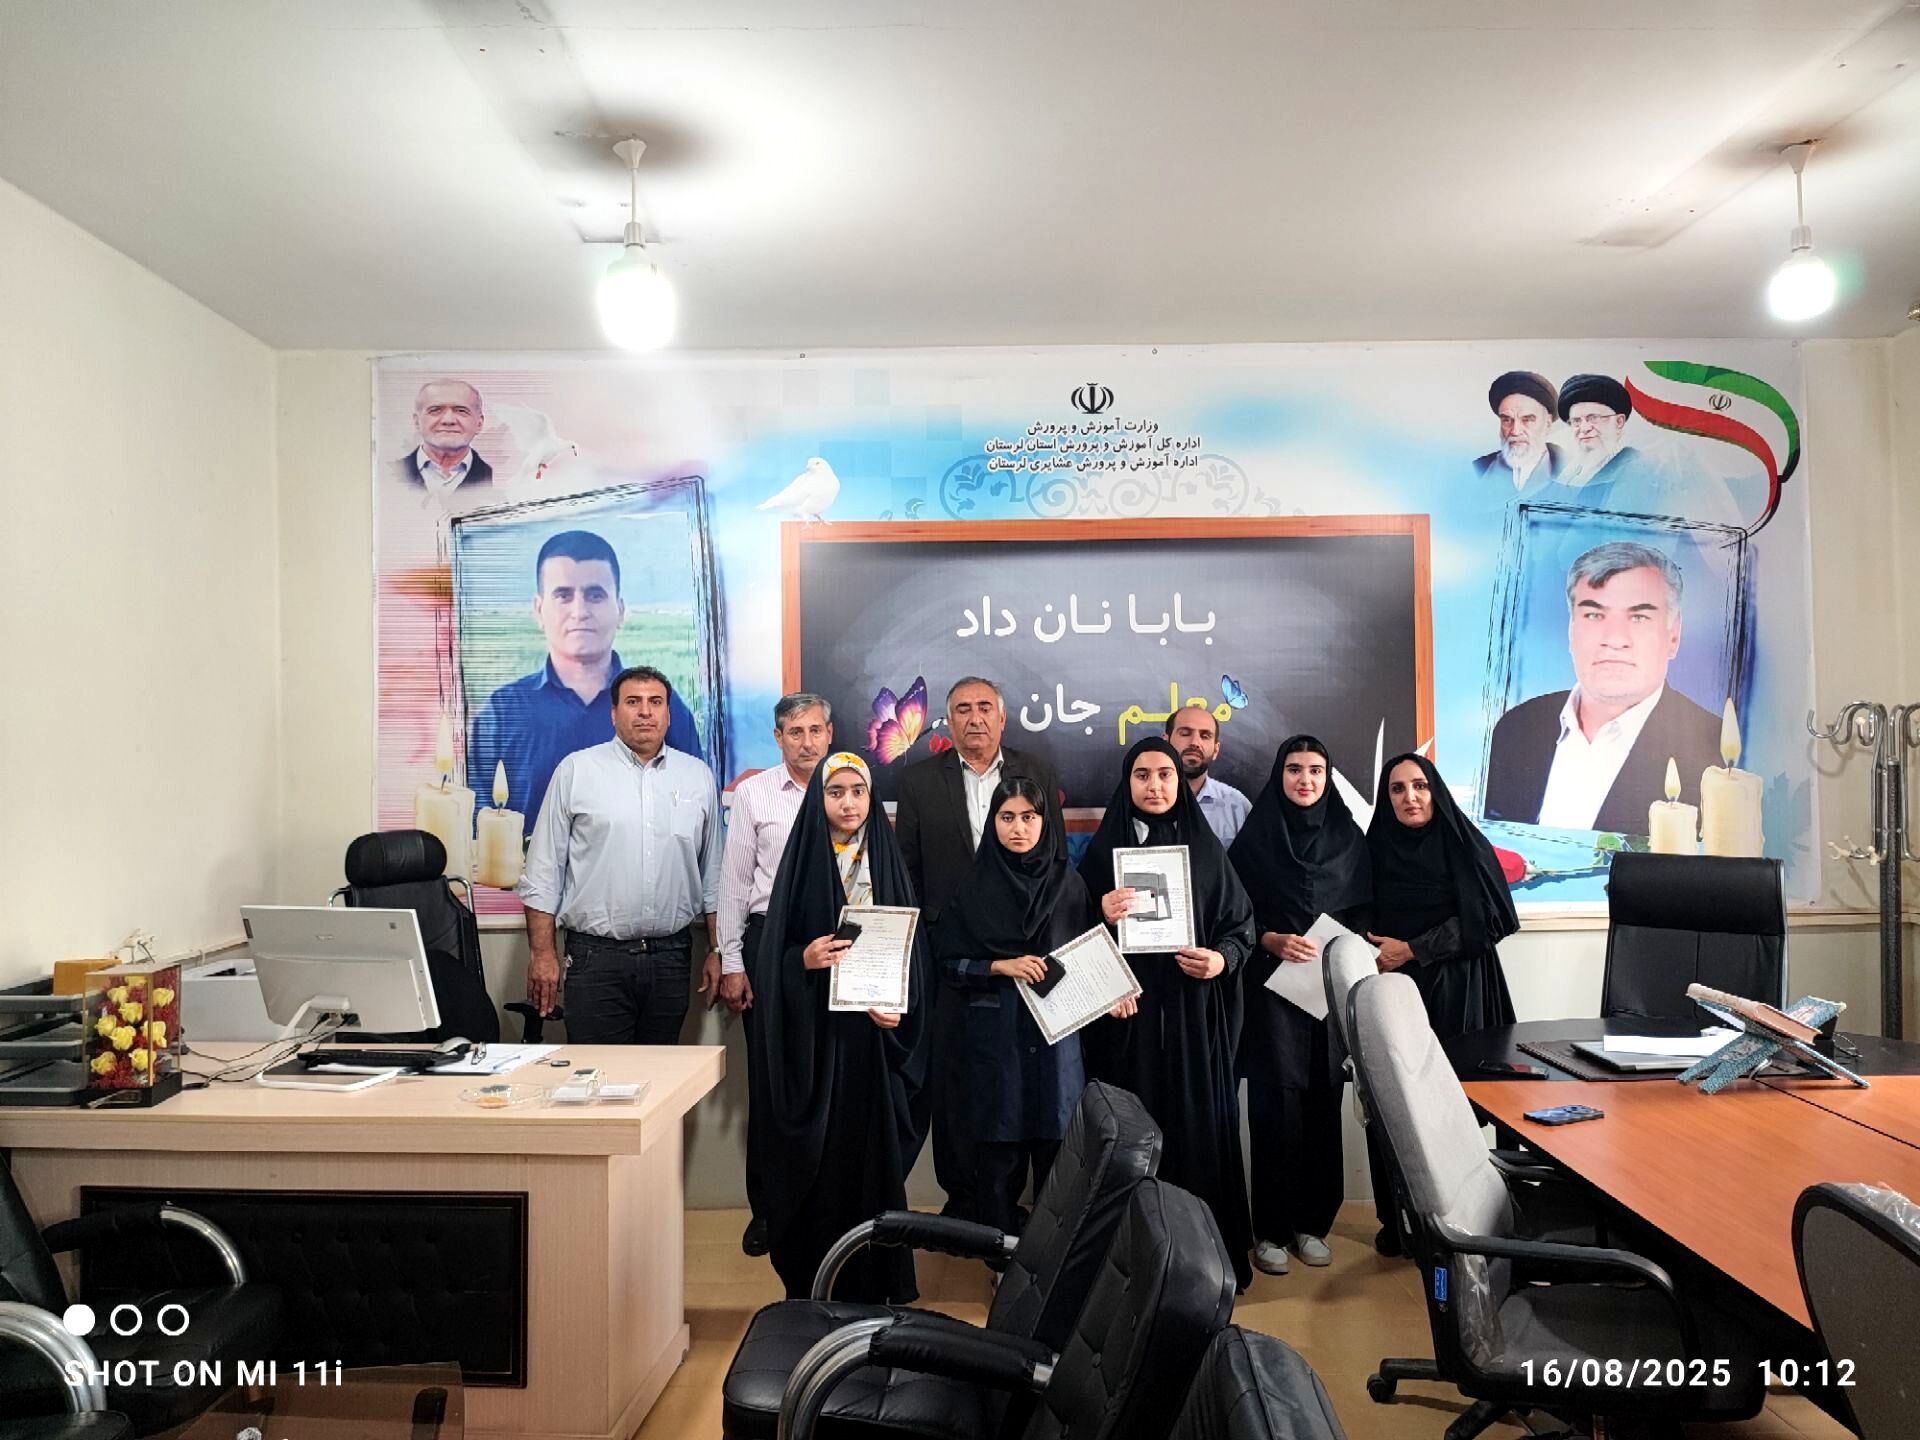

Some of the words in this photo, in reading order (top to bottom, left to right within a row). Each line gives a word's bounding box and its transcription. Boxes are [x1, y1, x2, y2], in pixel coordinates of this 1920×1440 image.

[1027, 421, 1067, 436] پرورش
[1070, 424, 1077, 434] و
[1080, 417, 1121, 436] آموزش
[1124, 419, 1159, 434] وزارت
[986, 438, 1024, 453] لرستان
[1026, 438, 1057, 452] استان
[1059, 439, 1100, 453] پرورش
[1103, 441, 1110, 452] و
[1112, 435, 1153, 453] آموزش
[1156, 436, 1173, 451] کل
[1175, 437, 1201, 451] اداره
[989, 457, 1027, 472] لرستان
[1029, 456, 1073, 471] عشایری
[1076, 457, 1116, 472] پرورش
[1119, 459, 1126, 470] و
[1129, 453, 1169, 472] آموزش
[1173, 455, 1198, 468] اداره
[956, 595, 1017, 637] داد
[1033, 593, 1112, 643] نان
[1128, 592, 1216, 646] بابا
[1019, 683, 1101, 735] جان
